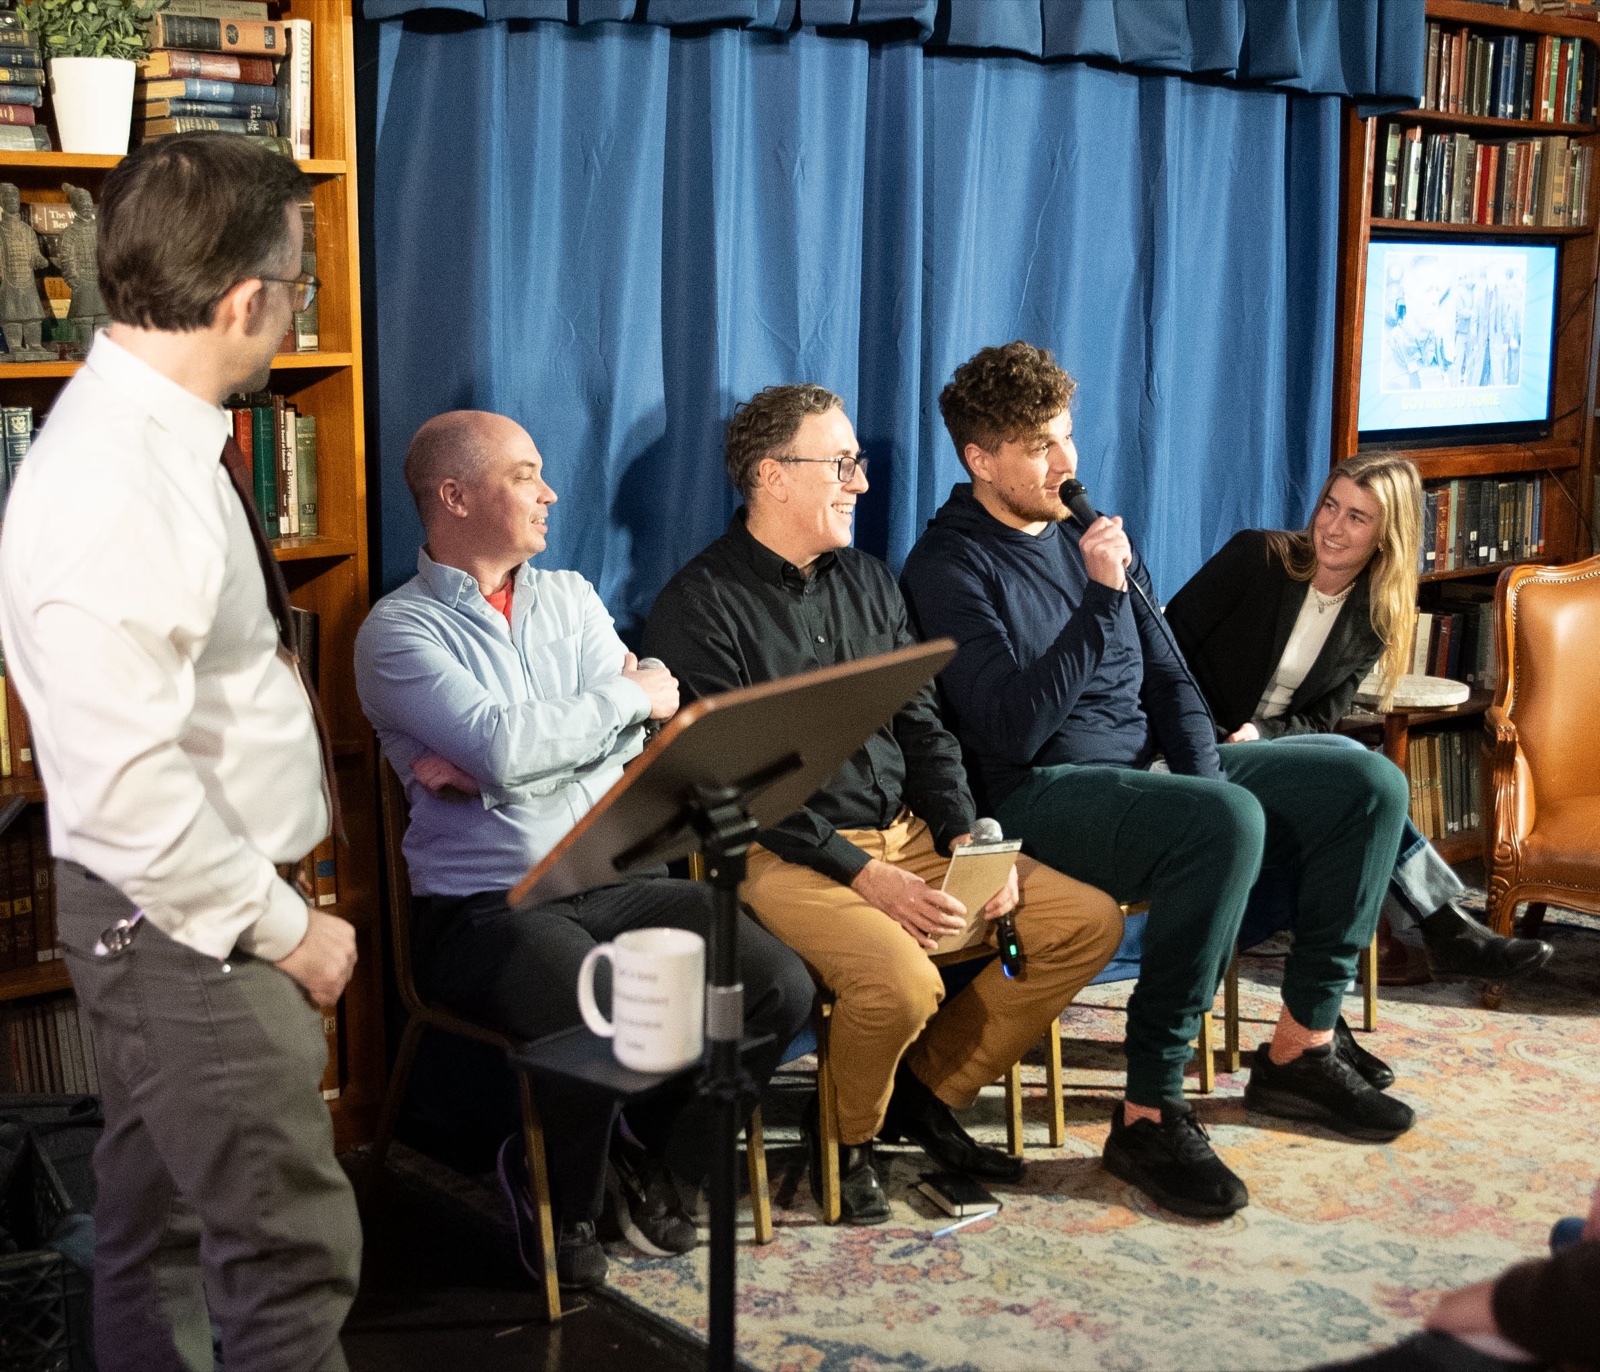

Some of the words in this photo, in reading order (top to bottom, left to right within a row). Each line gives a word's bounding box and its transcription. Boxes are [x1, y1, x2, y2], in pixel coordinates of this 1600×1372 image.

[301, 27, 310, 57] ZOO
[301, 61, 310, 87] VET
[48, 211, 66, 219] The
